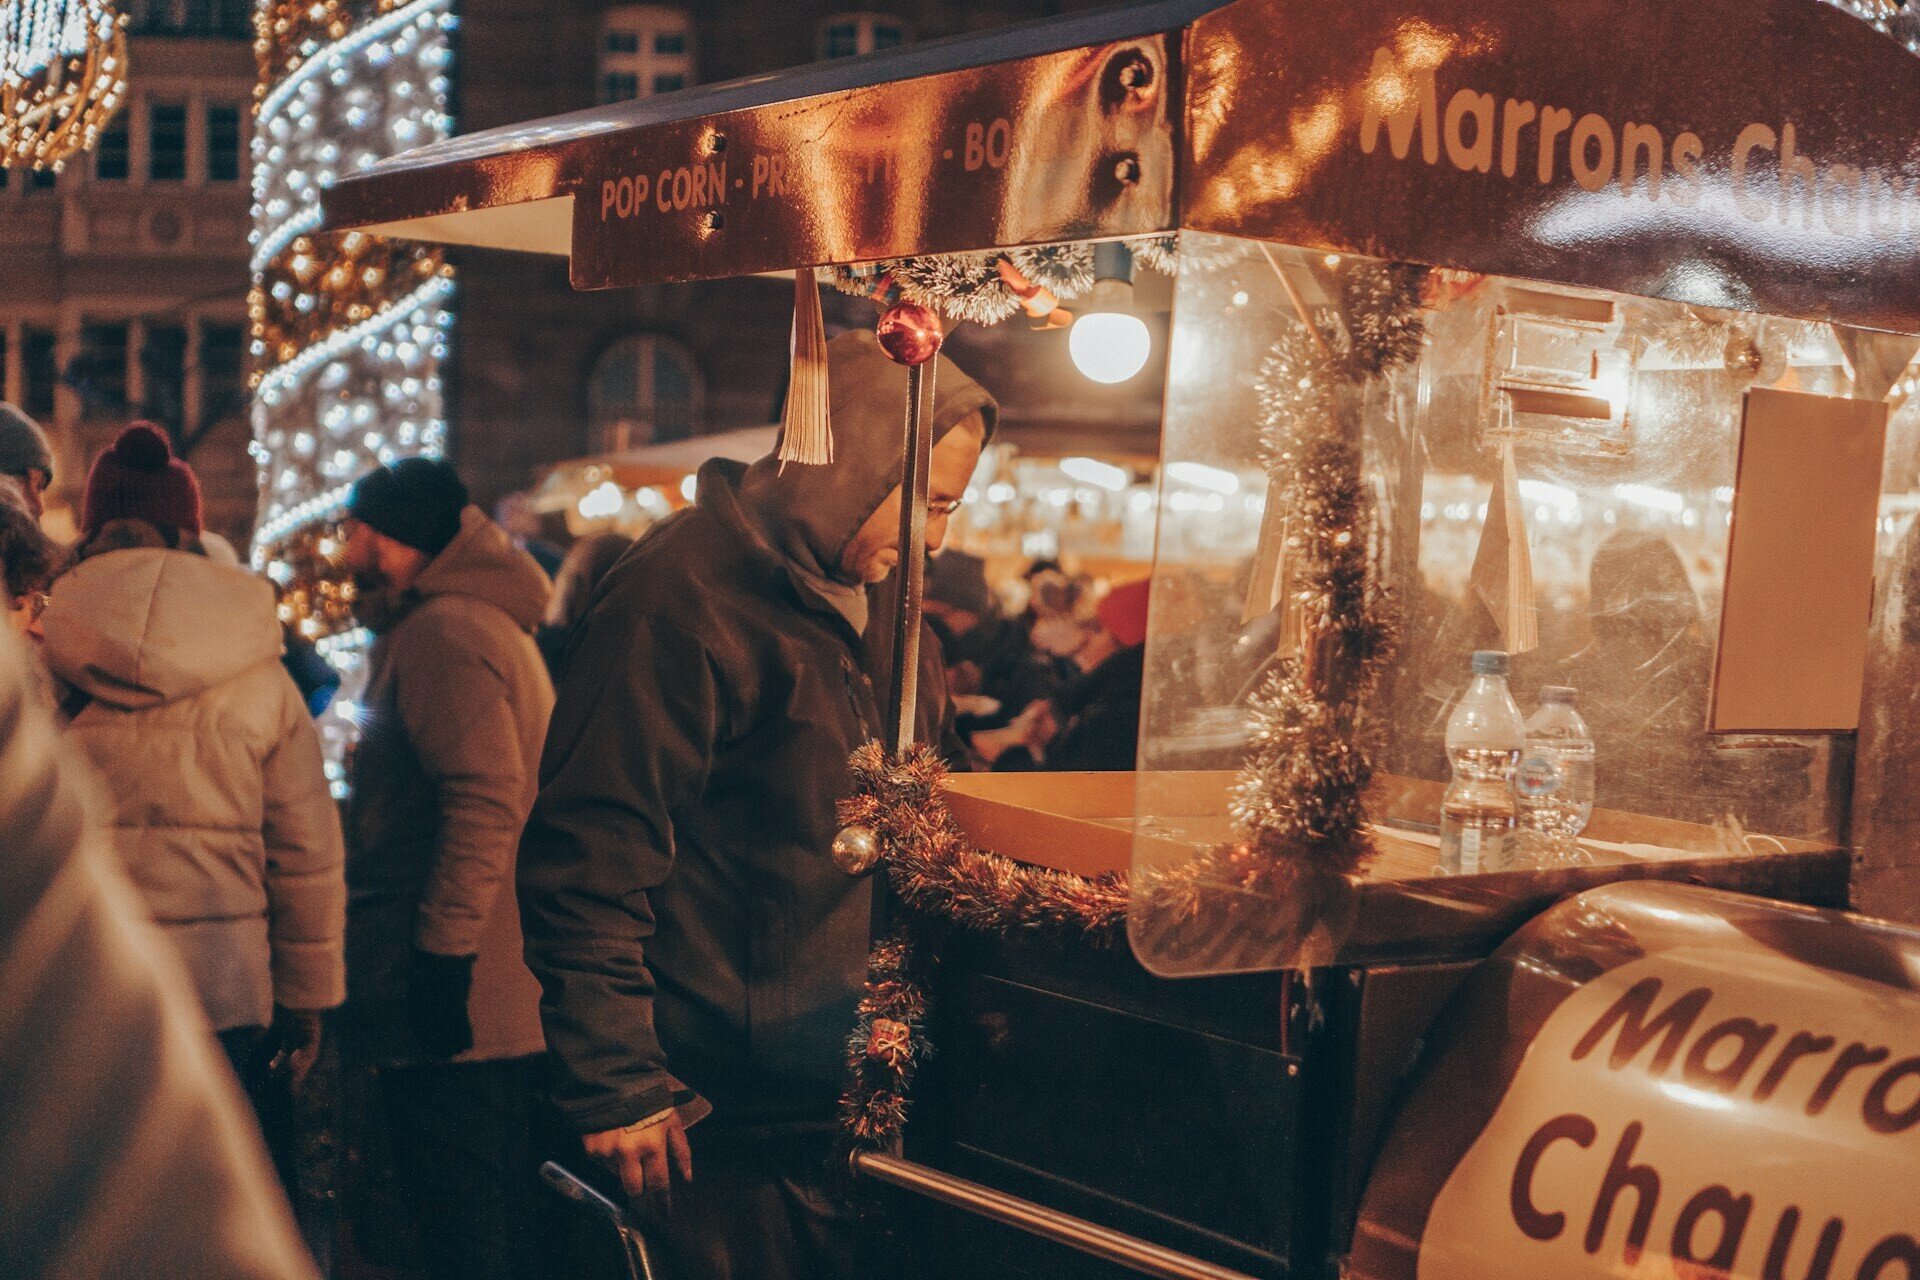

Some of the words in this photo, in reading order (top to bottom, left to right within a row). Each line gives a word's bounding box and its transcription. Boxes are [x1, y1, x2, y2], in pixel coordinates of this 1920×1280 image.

[602, 174, 649, 222] POP
[656, 161, 727, 213] CORN
[1359, 46, 1704, 208] Marrons
[1731, 122, 1920, 240] Chau
[1570, 976, 1920, 1135] Marro
